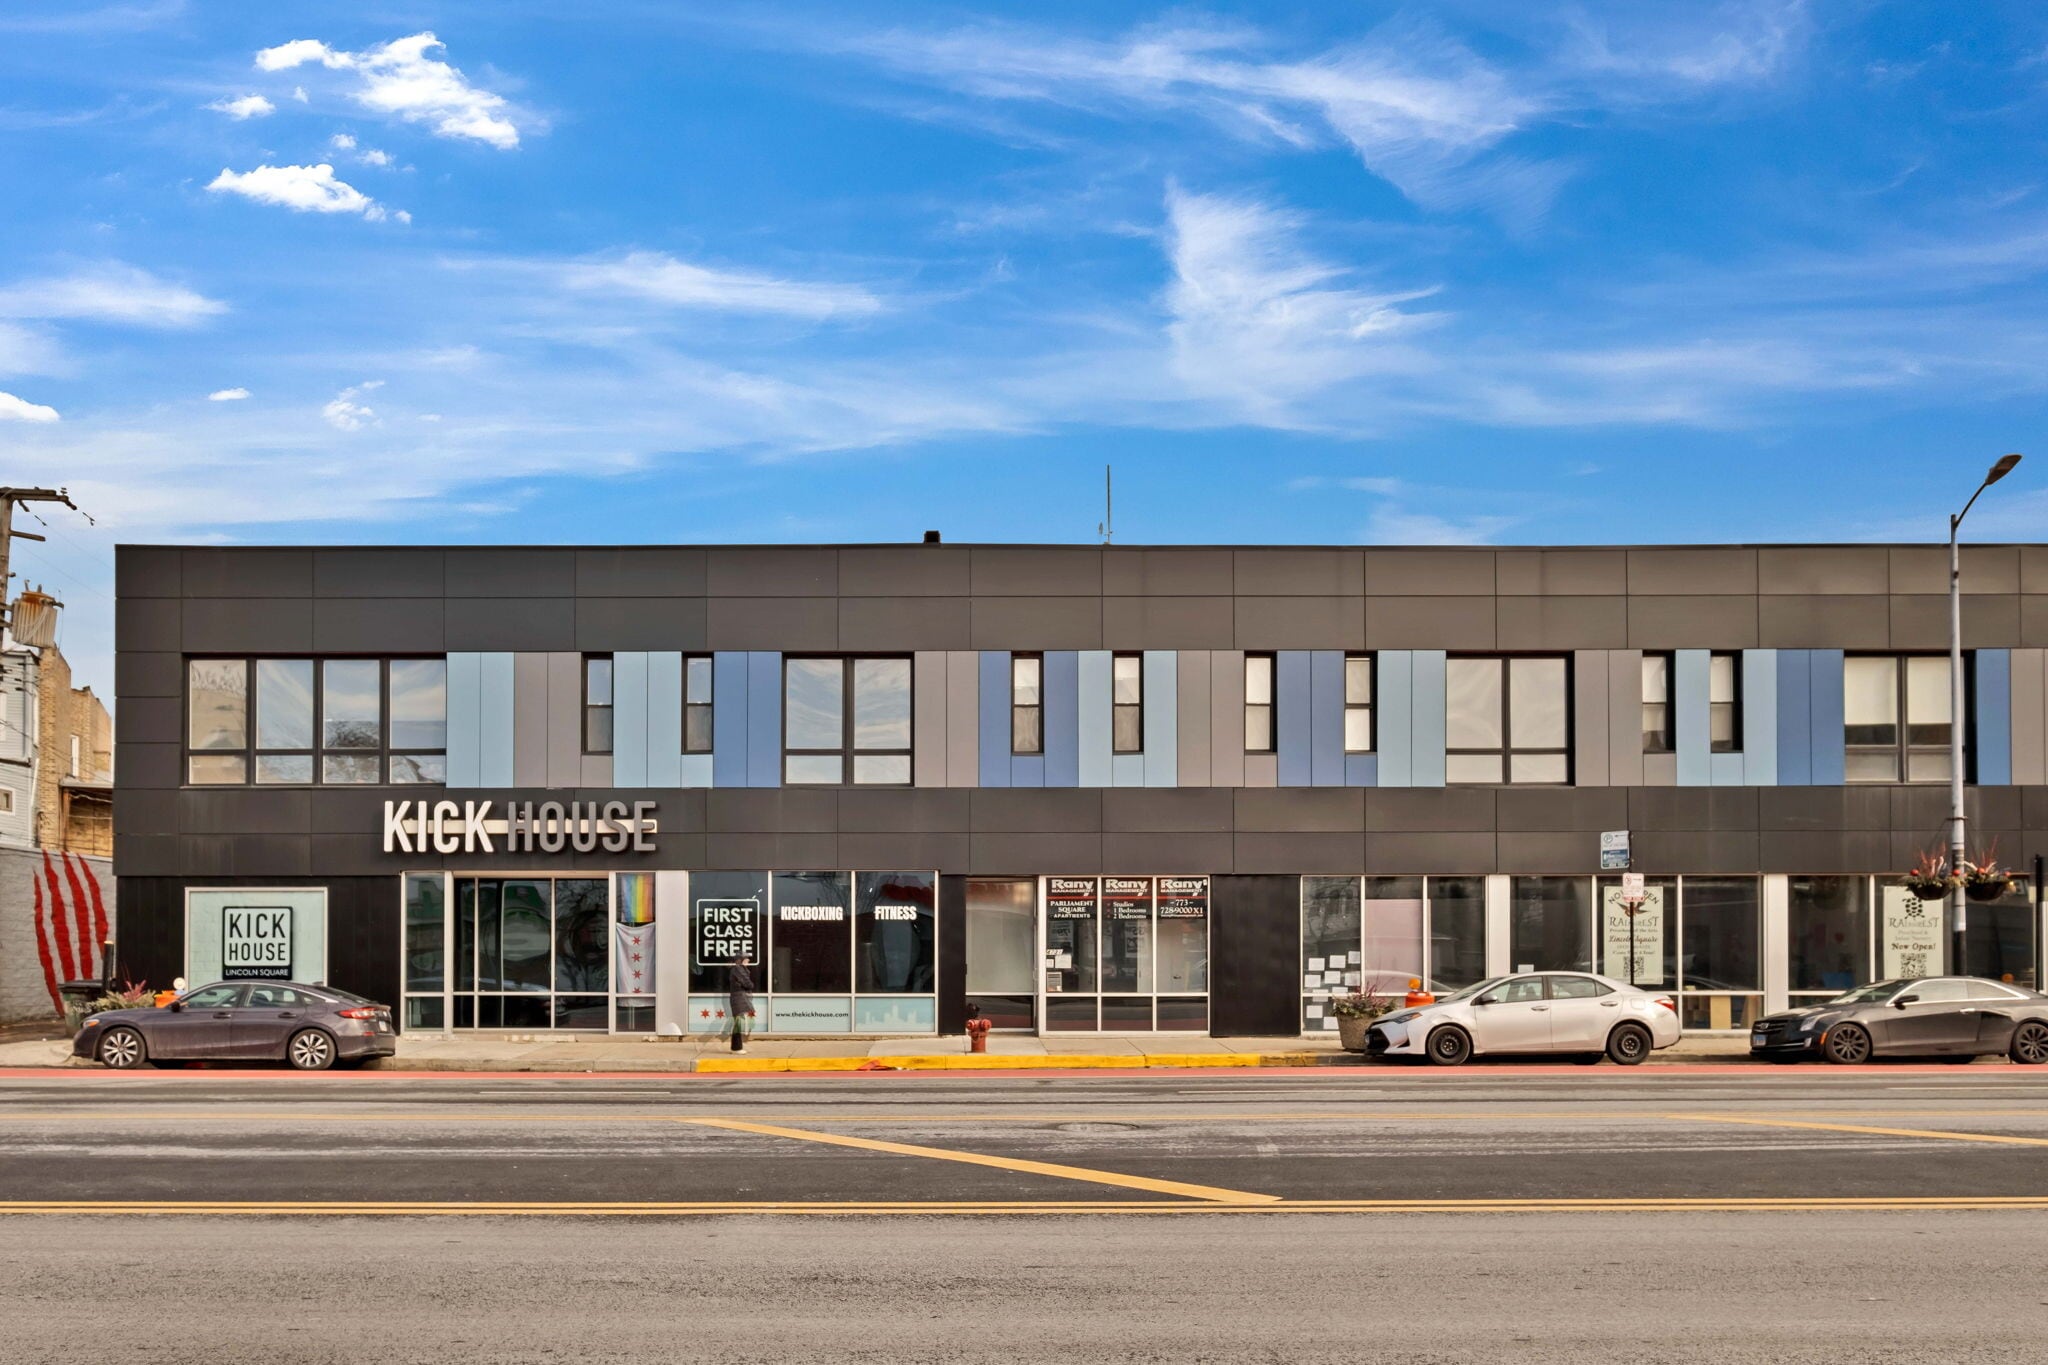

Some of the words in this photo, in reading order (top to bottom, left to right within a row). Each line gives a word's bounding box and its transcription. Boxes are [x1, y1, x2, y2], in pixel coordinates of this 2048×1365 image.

[384, 800, 494, 853] KICK
[508, 800, 656, 852] HOUSE
[1051, 879, 1094, 897] Rany
[1105, 879, 1148, 897] Rany
[1160, 879, 1203, 897] Rany
[704, 908, 752, 923] FIRST
[781, 906, 843, 921] KICKBOXING
[874, 906, 917, 920] FITNESS
[1058, 906, 1086, 914] SQUARE
[229, 913, 286, 938] KICK
[704, 925, 752, 938] CLASS
[229, 943, 286, 961] HOUSE
[704, 939, 752, 957] FREE
[1891, 942, 1909, 951] Now
[259, 969, 289, 977] SQUARE
